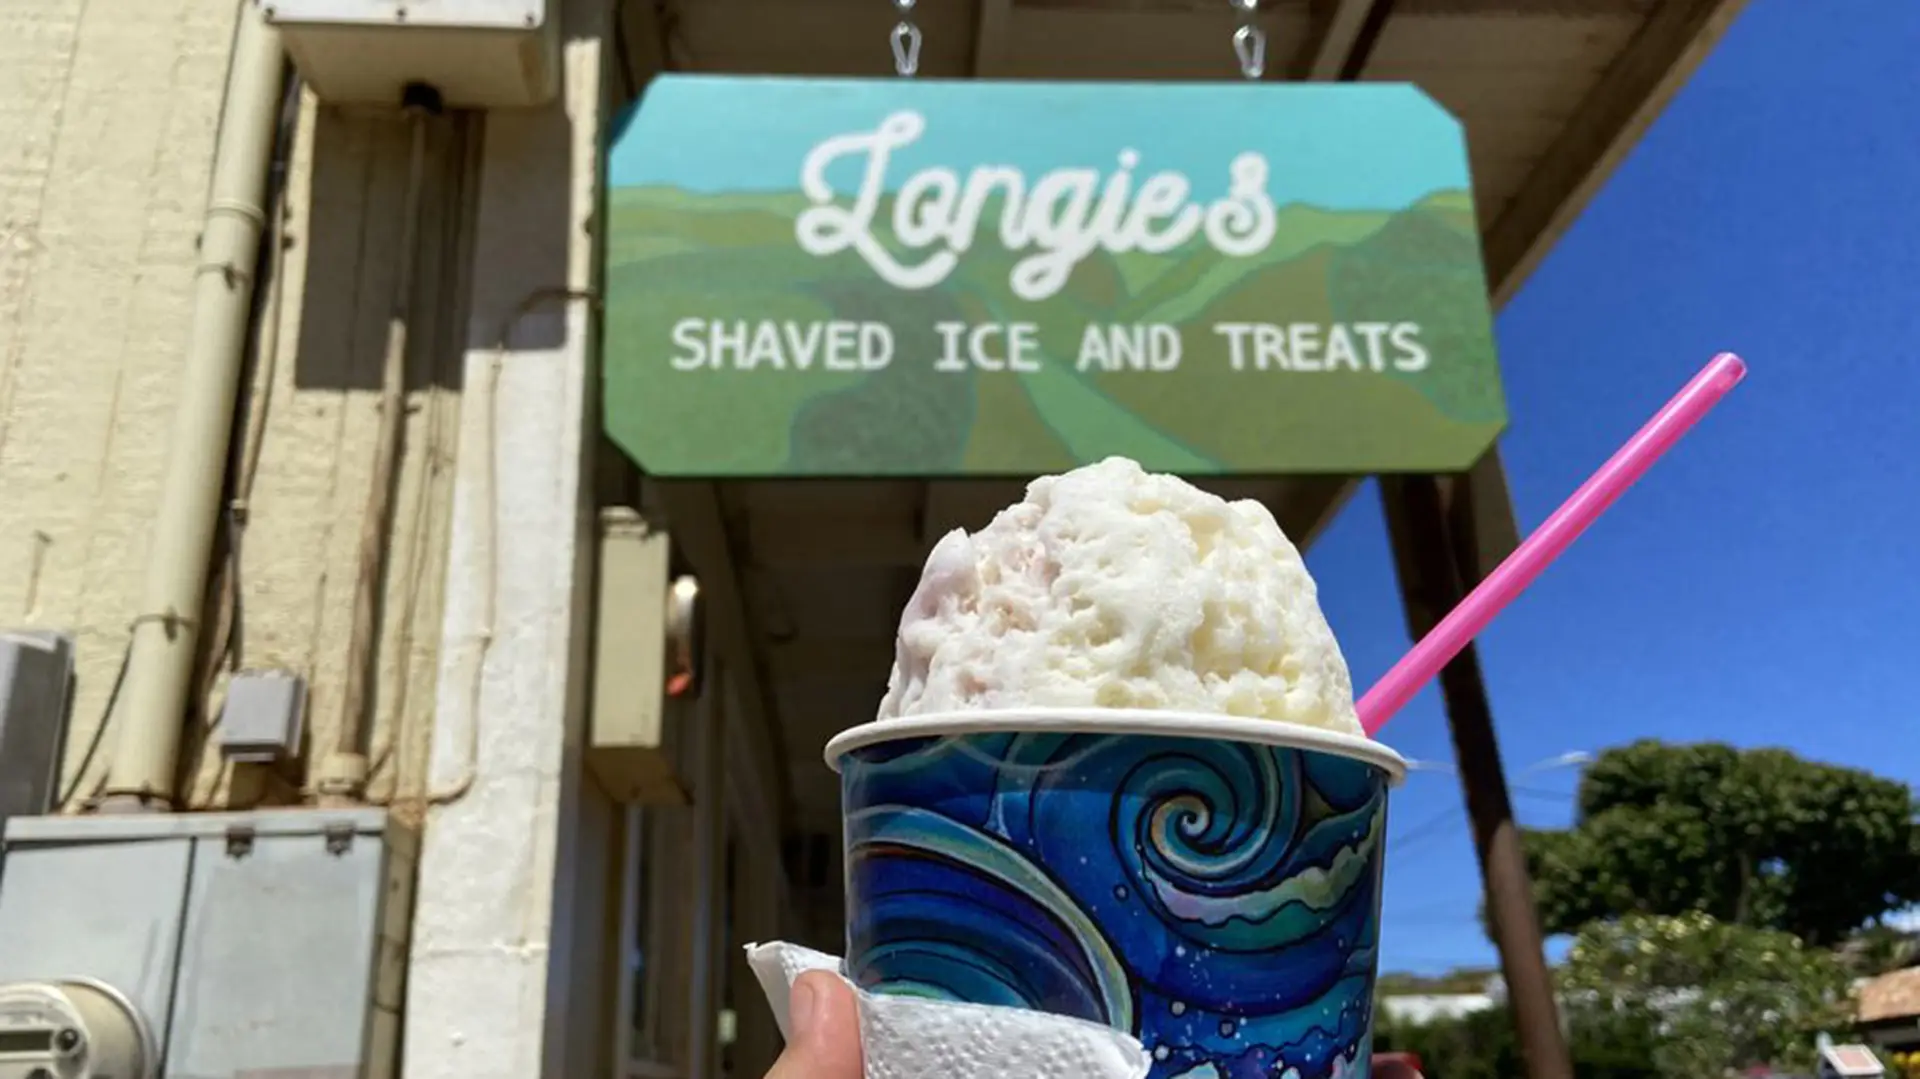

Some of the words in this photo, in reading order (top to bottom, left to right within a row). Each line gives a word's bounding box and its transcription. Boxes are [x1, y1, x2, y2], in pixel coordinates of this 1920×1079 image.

[795, 109, 1278, 300] Longies
[670, 318, 893, 371] SHAVED
[934, 321, 1040, 372] ICE
[1076, 323, 1181, 371] AND
[1214, 321, 1429, 372] TREATS
